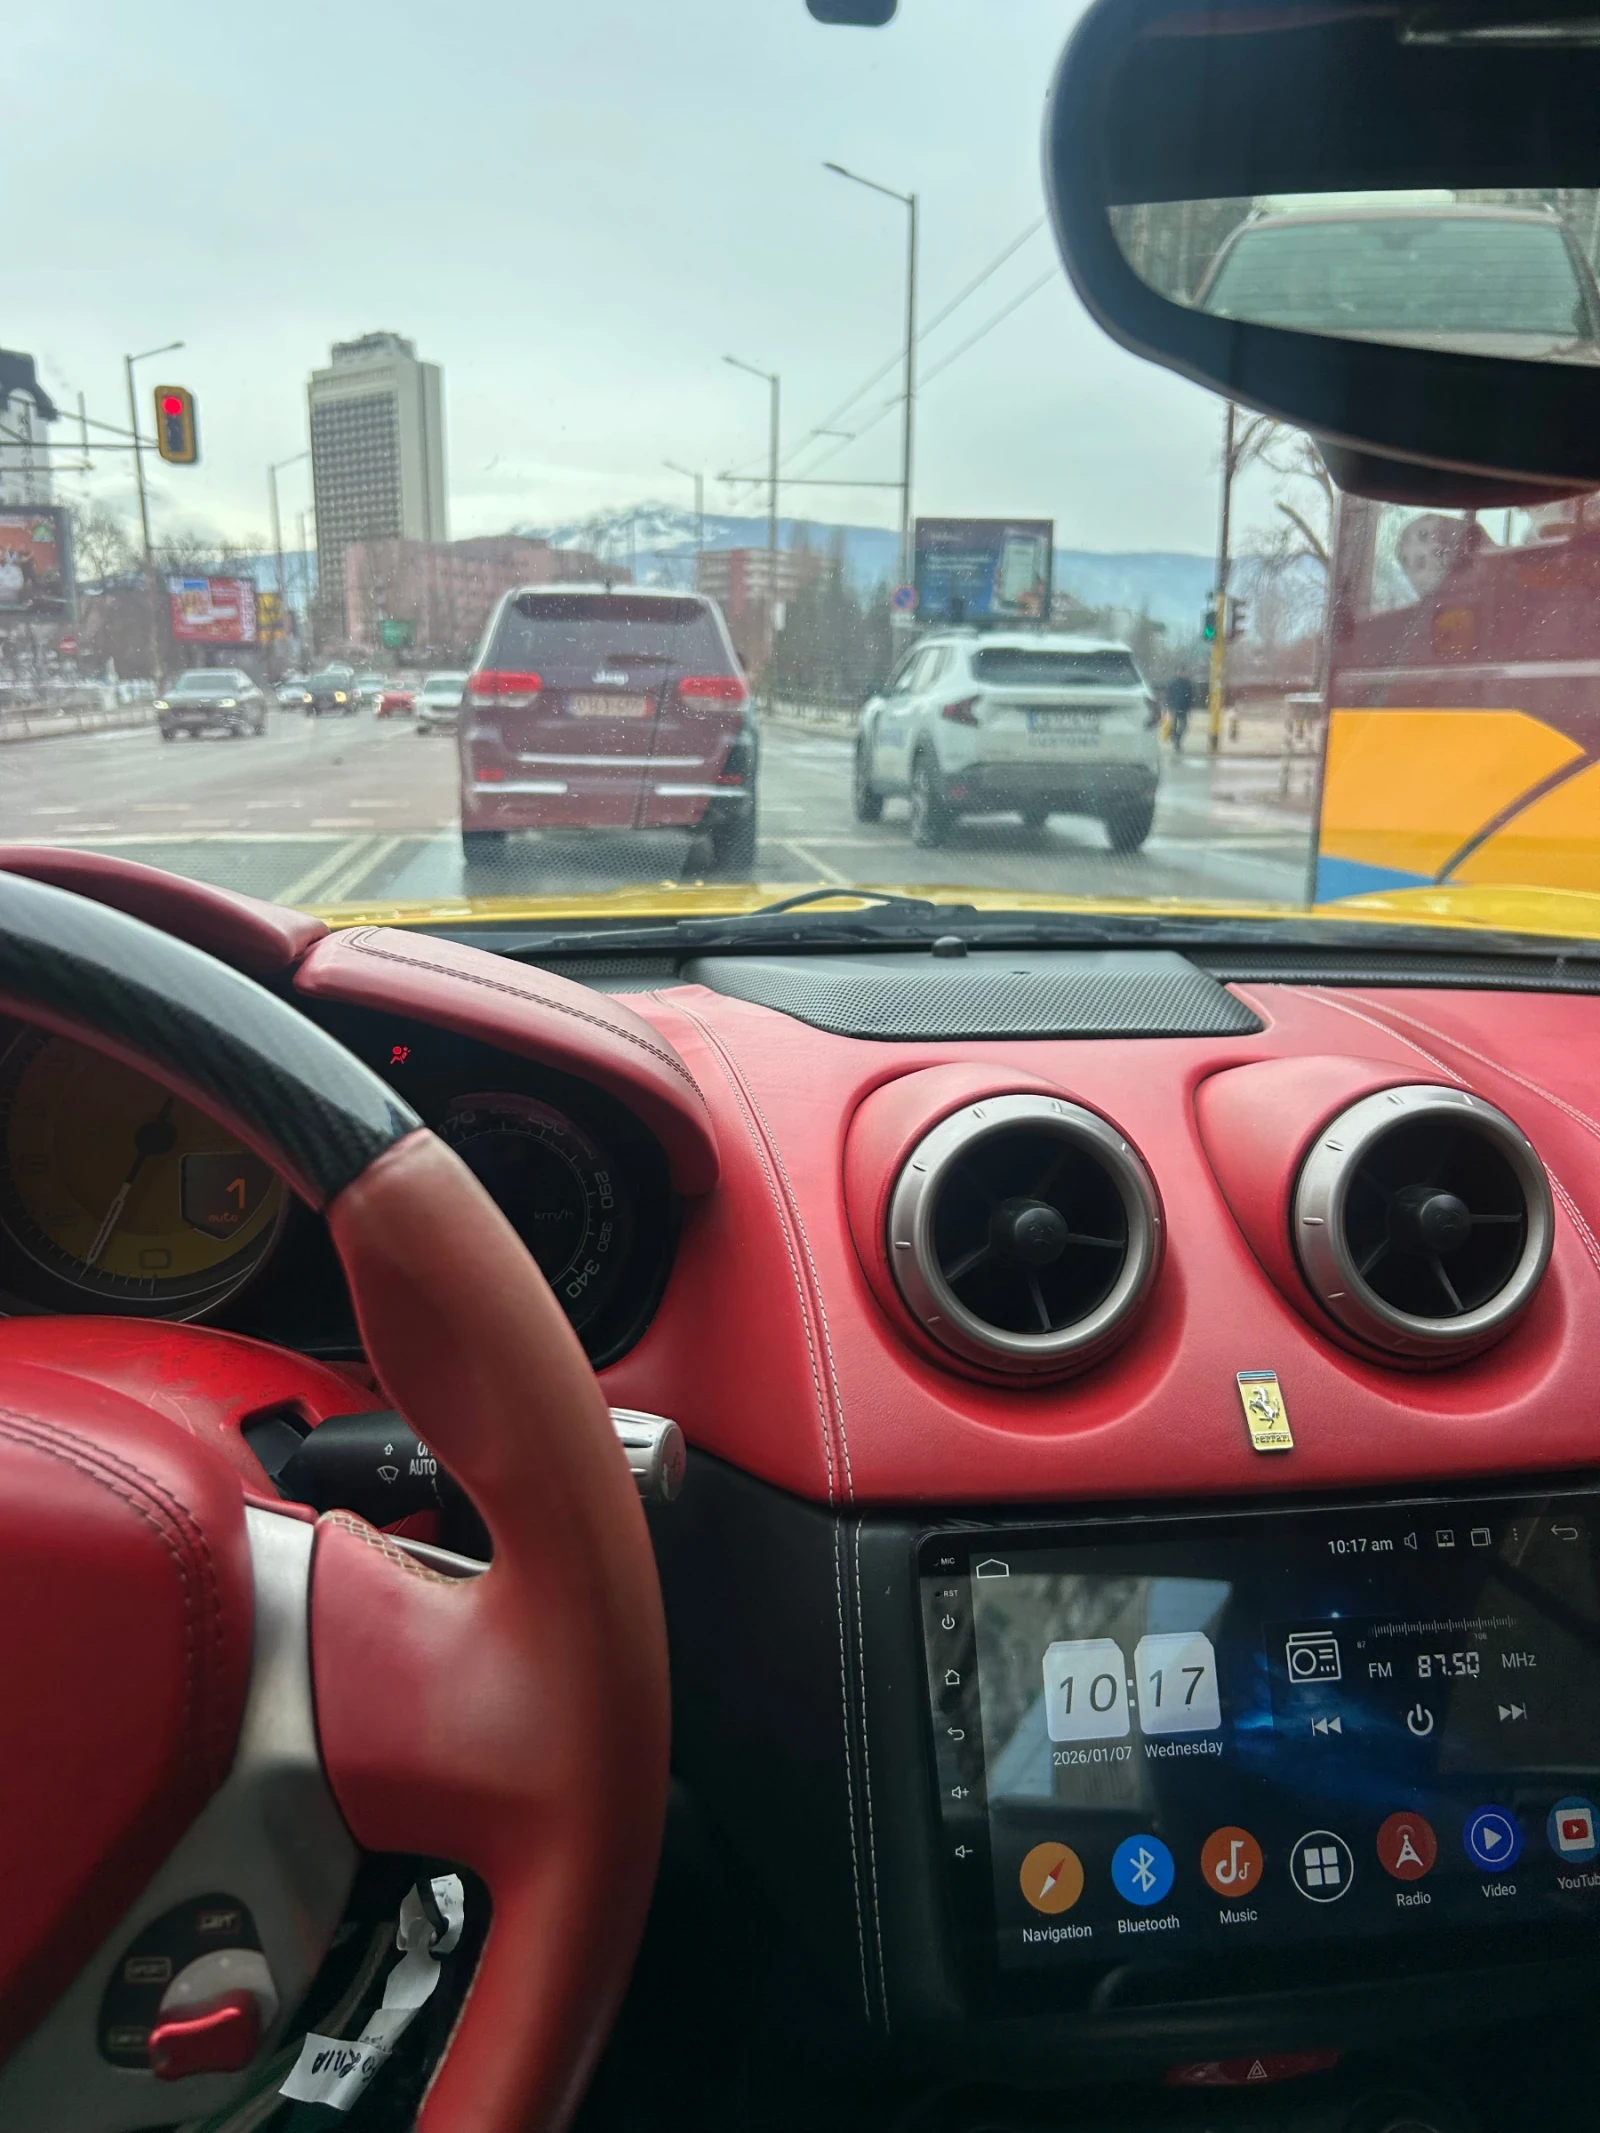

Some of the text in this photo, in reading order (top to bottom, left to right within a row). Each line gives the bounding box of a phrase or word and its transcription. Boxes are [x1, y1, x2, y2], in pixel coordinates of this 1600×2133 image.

[226, 1178, 246, 1209] 1
[534, 1208, 575, 1223] km/h
[566, 1259, 600, 1298] 340
[409, 1458, 437, 1476] AUTO
[1327, 1538, 1394, 1554] 10:17 am
[941, 1557, 955, 1565] MIC
[943, 1589, 958, 1597] RST
[1368, 1651, 1537, 1678] FM 87.50 MHz
[1053, 1739, 1223, 1766] 2026/01/07 Wednesday
[1481, 1883, 1517, 1897] Video
[1557, 1872, 1600, 1890] YouTub
[1396, 1891, 1432, 1906] Radio
[1117, 1915, 1180, 1933] Bluetooth
[1219, 1908, 1259, 1924] Music
[1022, 1925, 1093, 1943] Navigation
